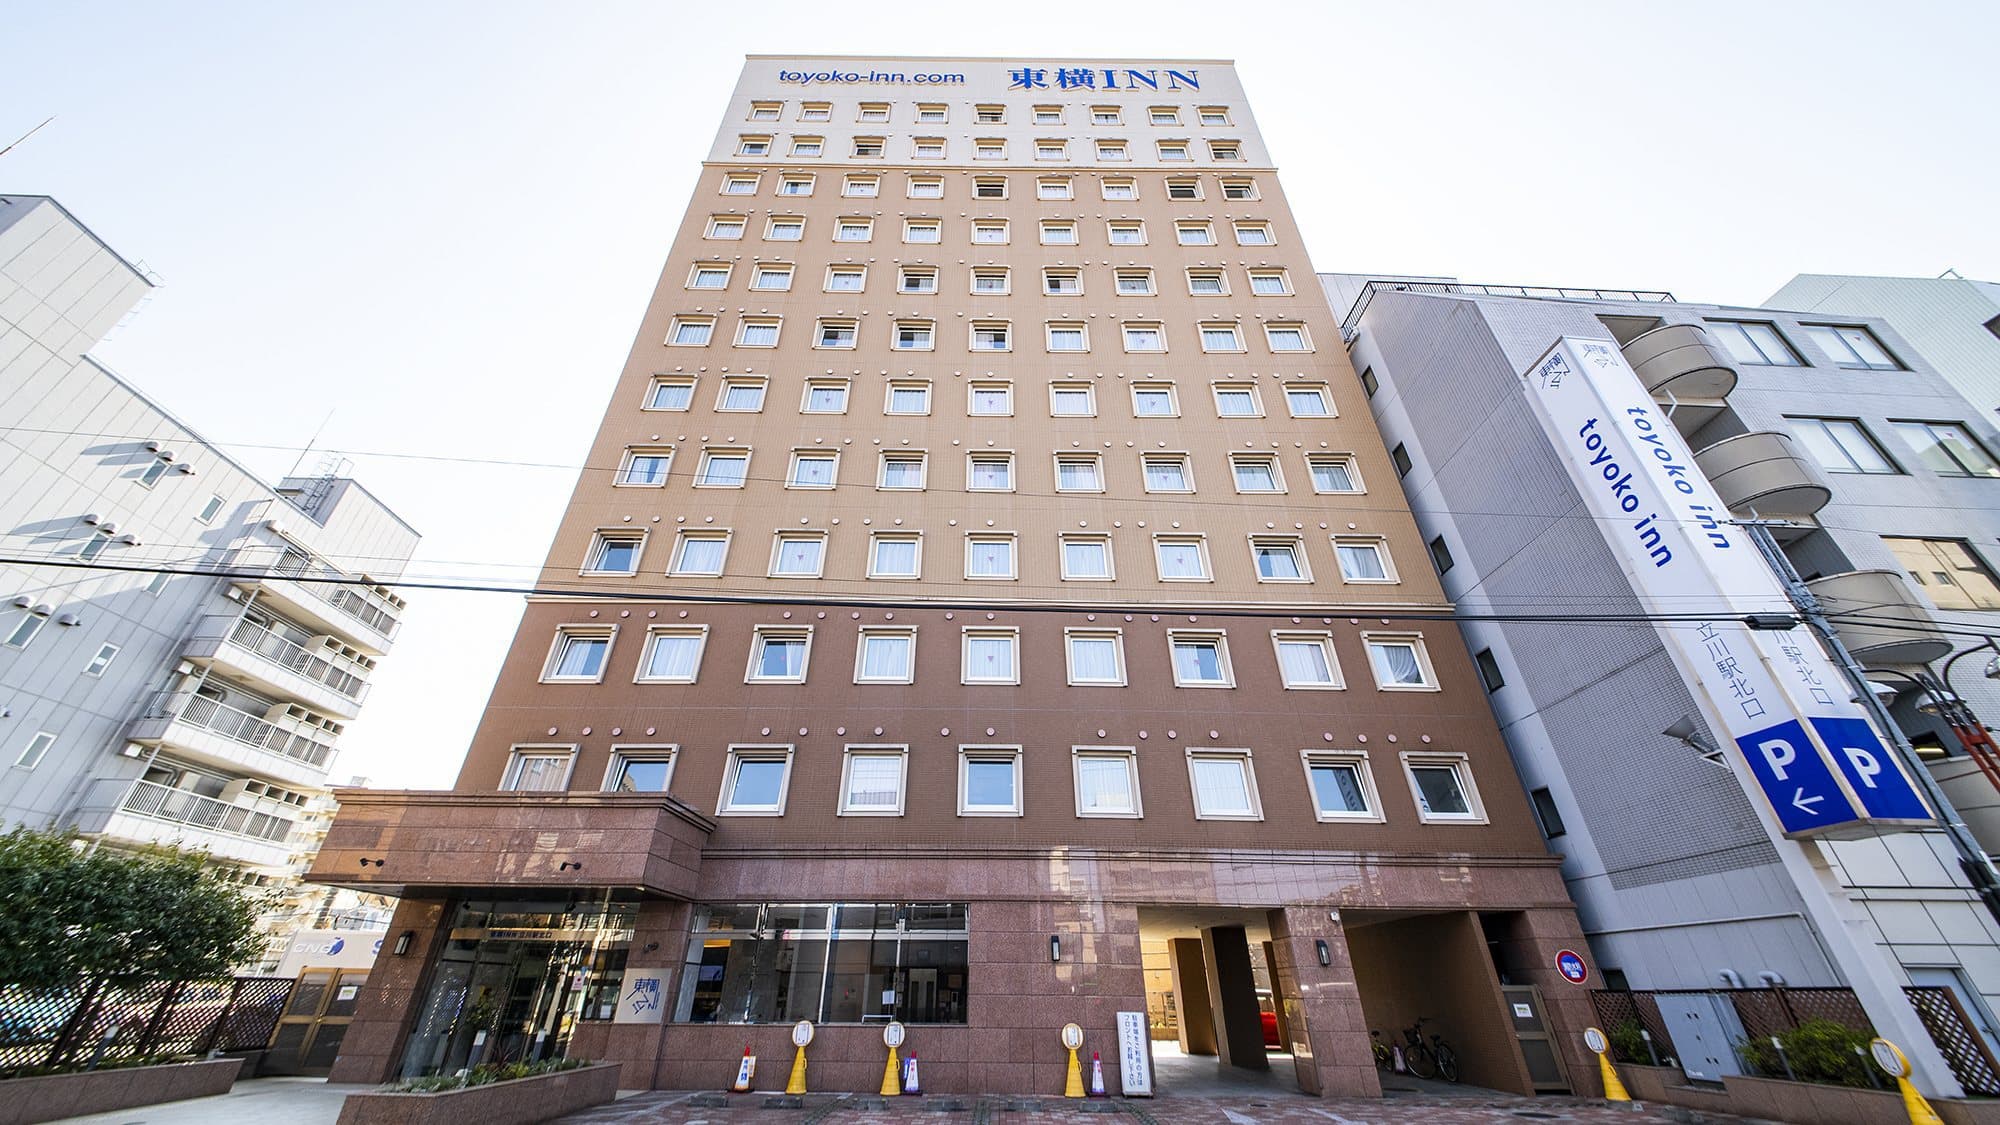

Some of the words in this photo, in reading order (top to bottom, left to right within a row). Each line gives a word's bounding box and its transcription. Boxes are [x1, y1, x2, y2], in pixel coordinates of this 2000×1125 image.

[778, 69, 966, 85] toyoko-inn.com
[1007, 67, 1201, 91] 東横INN
[1579, 417, 1640, 513] toyoko
[1633, 513, 1673, 568] inn
[1627, 406, 1694, 495] toyoko
[1689, 505, 1731, 549] inn
[1696, 621, 1766, 720] 立川駅北口
[1764, 609, 1835, 705] 川駅北口
[1758, 738, 1796, 782] P
[1842, 747, 1881, 788] P
